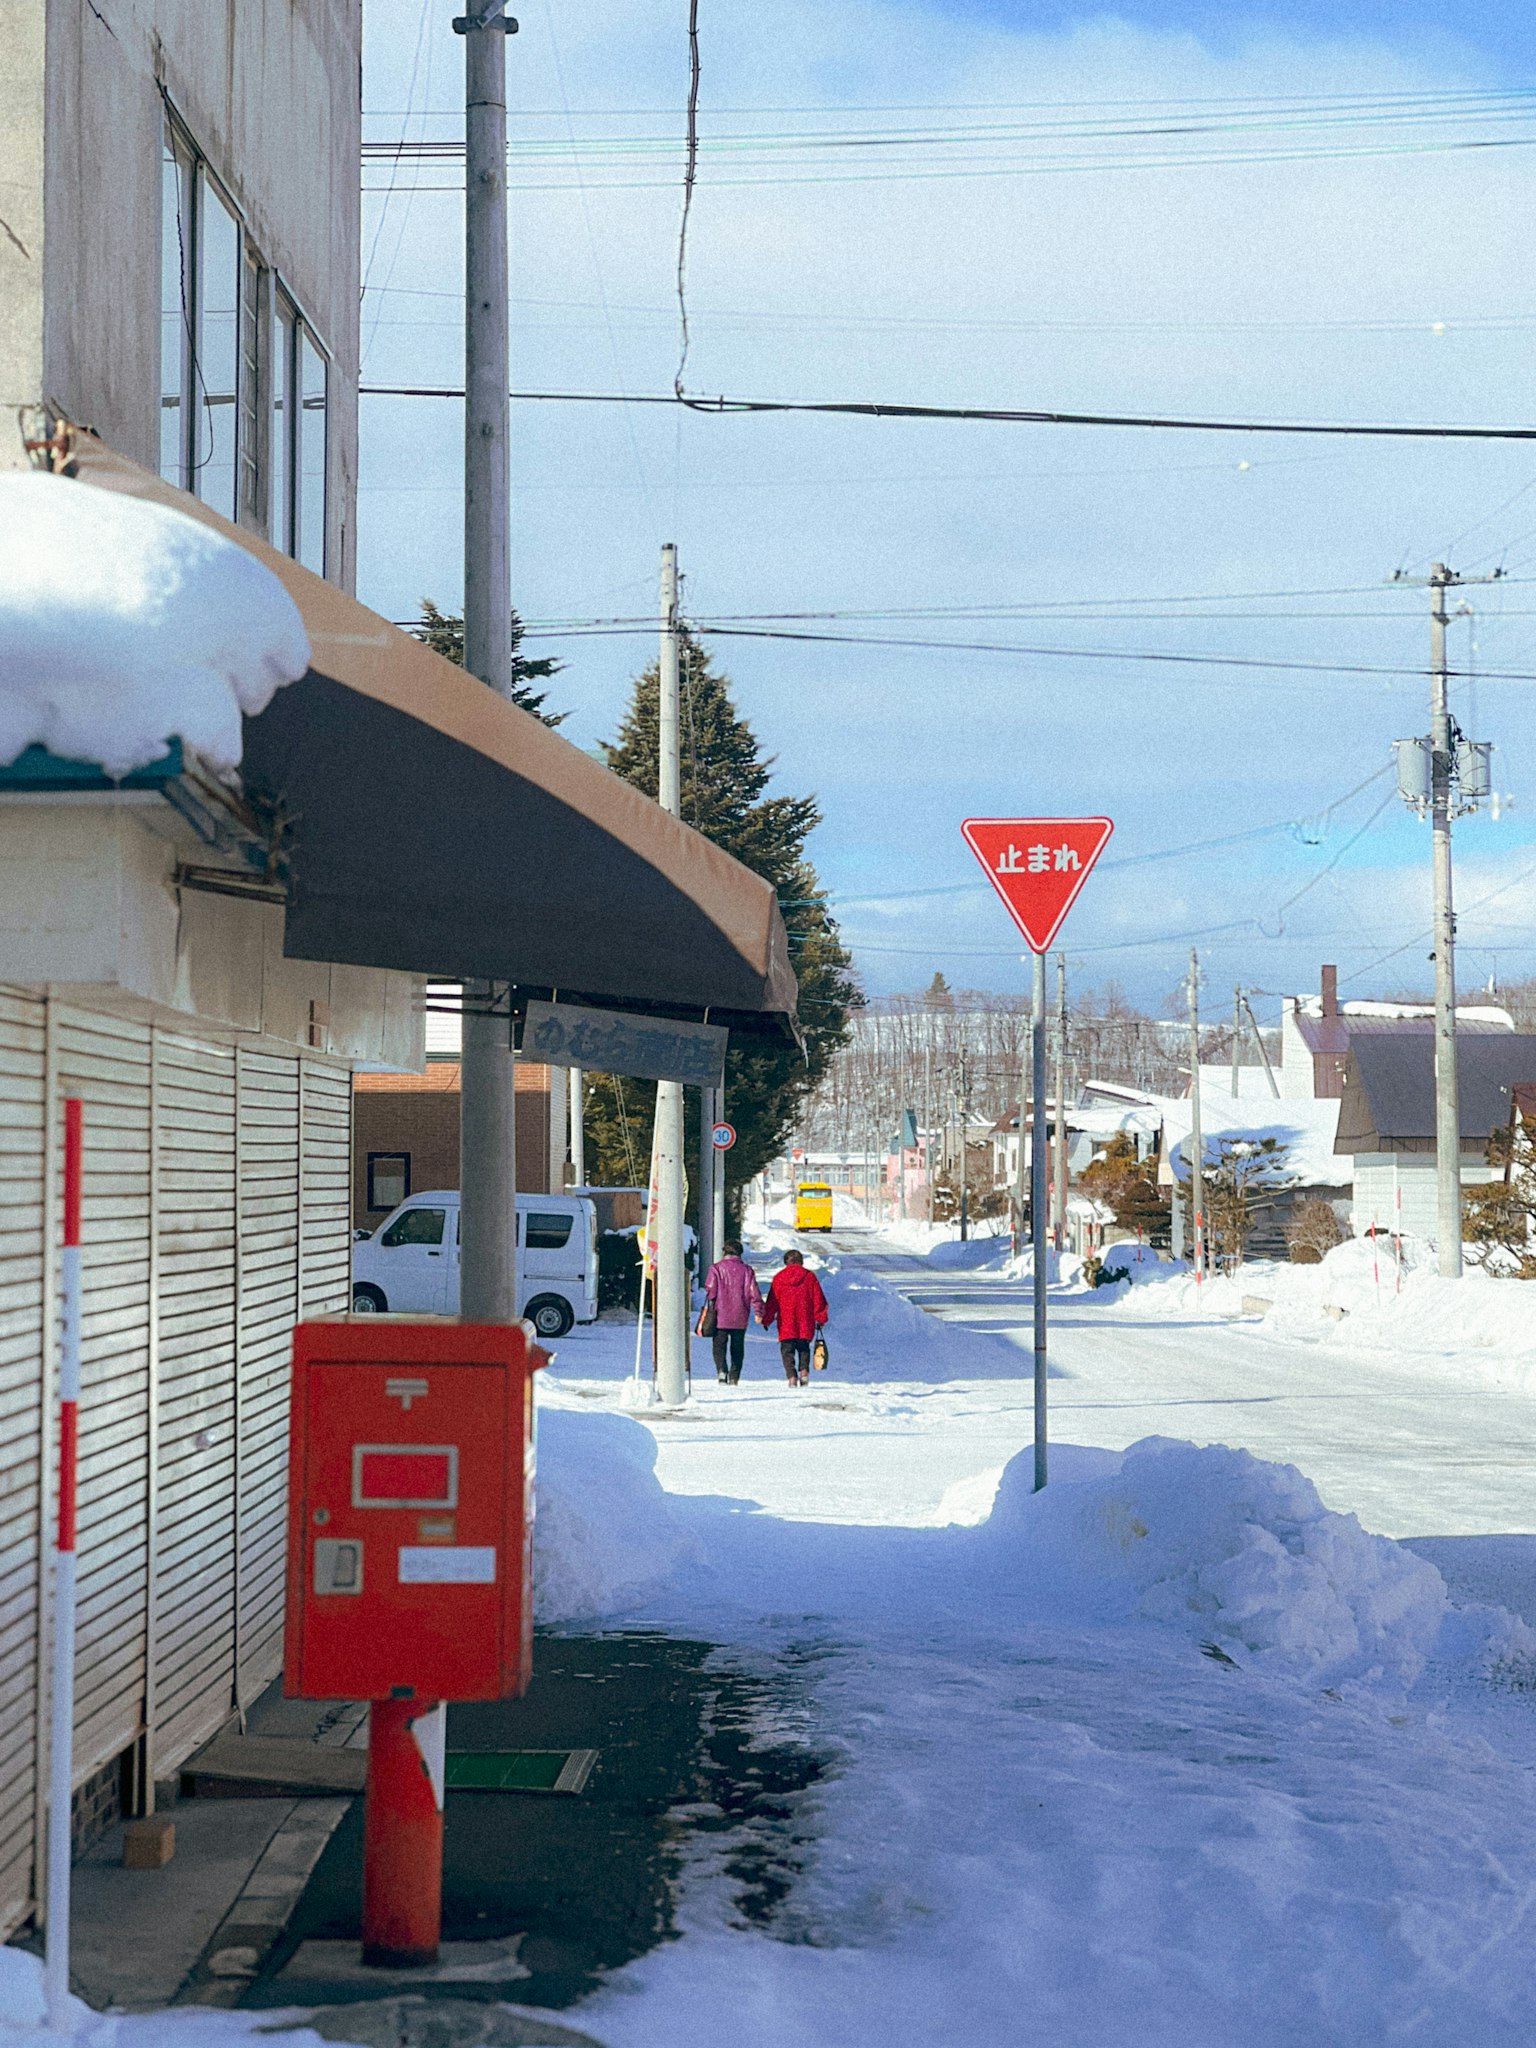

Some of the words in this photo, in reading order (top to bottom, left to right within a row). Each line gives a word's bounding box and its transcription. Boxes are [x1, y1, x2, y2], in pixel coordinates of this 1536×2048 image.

[995, 843, 1082, 874] 止まれ
[715, 1130, 730, 1142] 30
